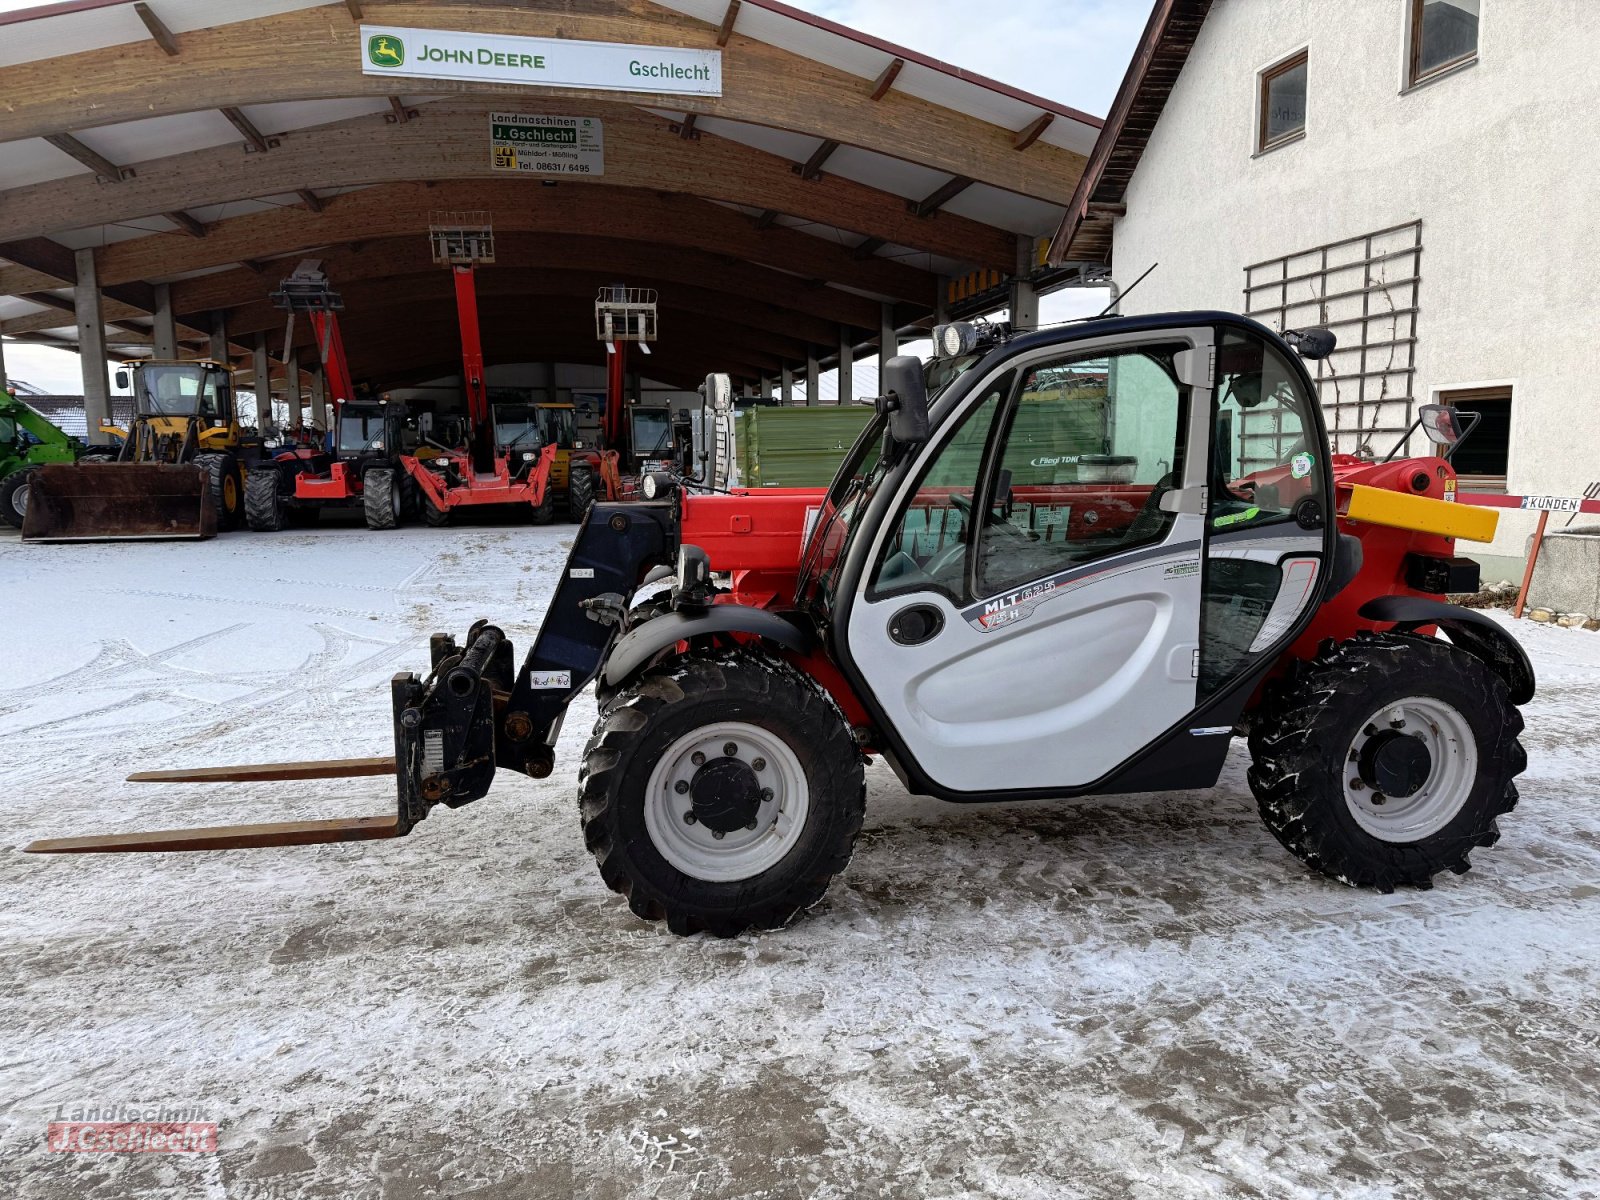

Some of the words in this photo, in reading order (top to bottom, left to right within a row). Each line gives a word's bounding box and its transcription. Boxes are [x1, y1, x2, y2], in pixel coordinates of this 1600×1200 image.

[416, 44, 474, 65] JOHN
[477, 48, 546, 70] DEERE
[629, 60, 710, 81] Gschlecht
[491, 113, 577, 127] Landmaschinen
[495, 127, 507, 139] J.
[509, 128, 575, 142] Gschlecht
[517, 149, 547, 158] Mühldorf
[518, 162, 534, 170] Tel.
[568, 163, 590, 173] 6495
[1530, 498, 1577, 510] KUNDEN
[984, 593, 1019, 615] MLT
[1021, 580, 1056, 602] 625
